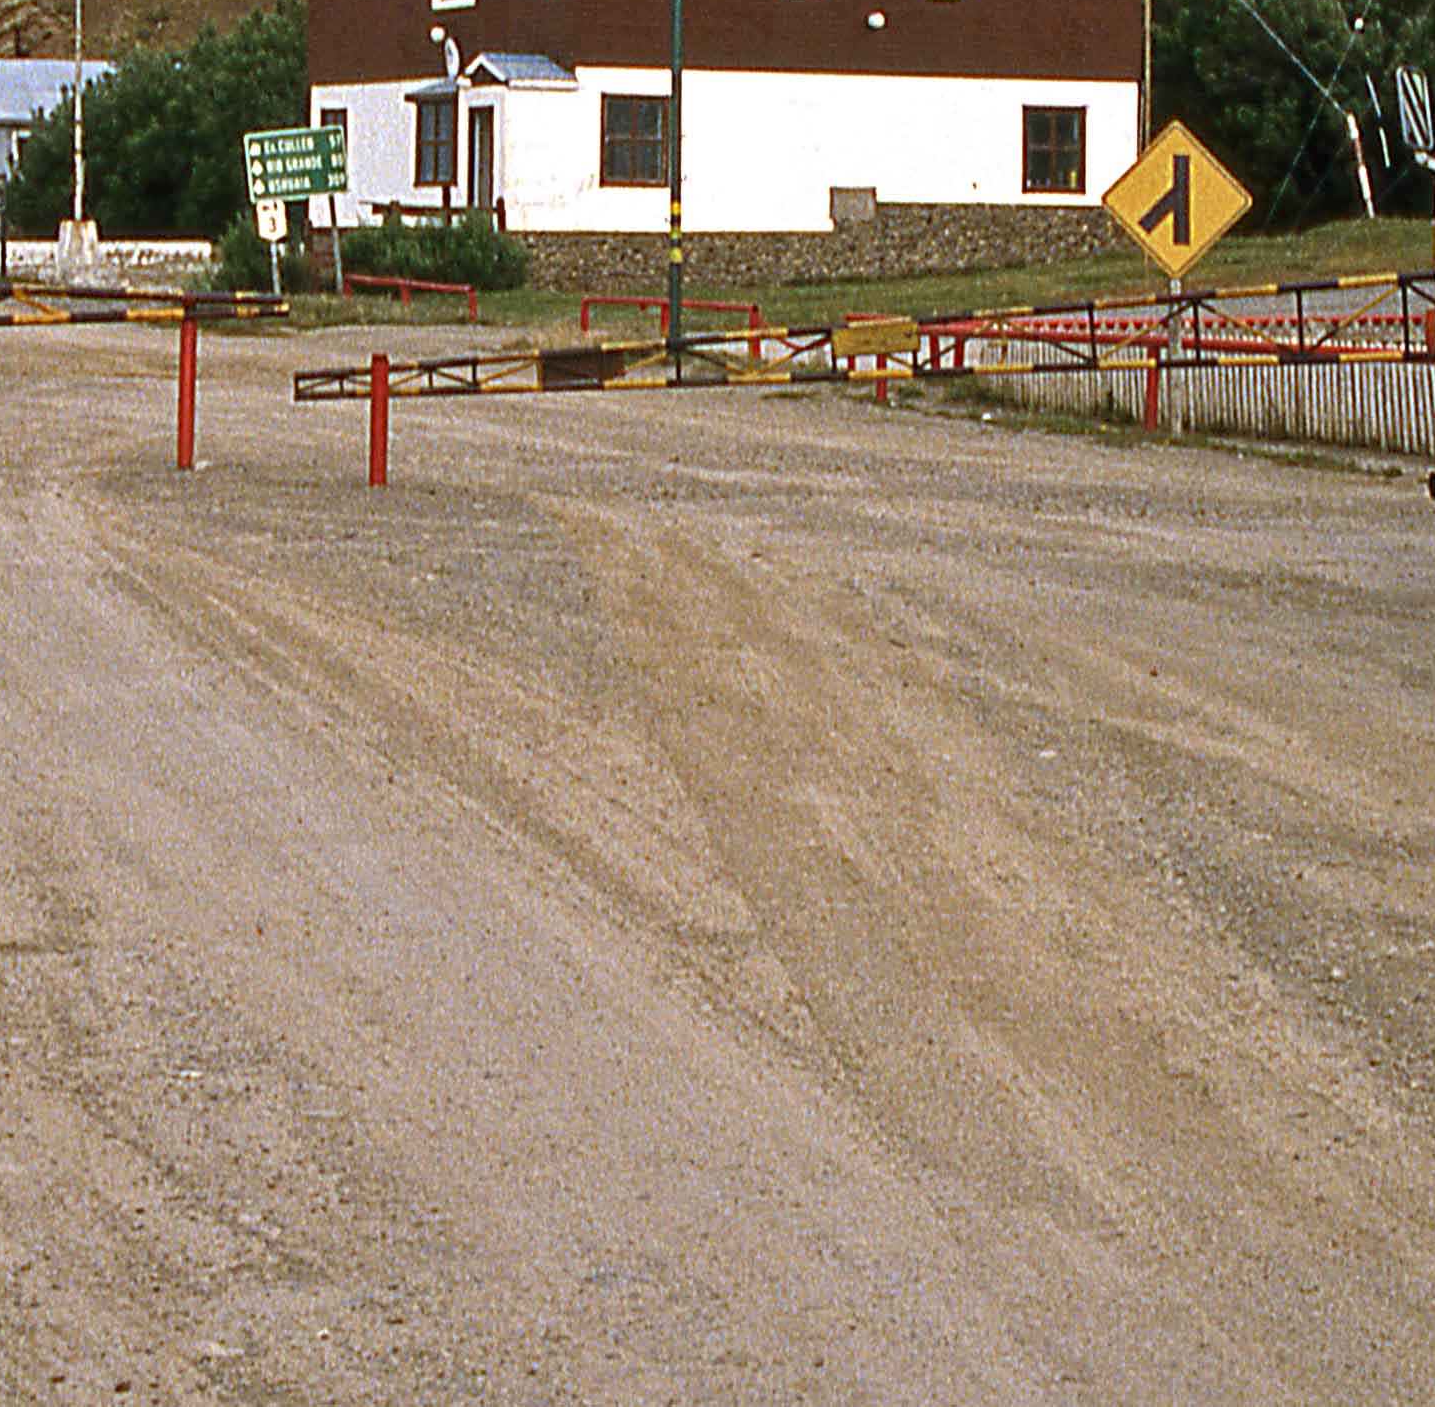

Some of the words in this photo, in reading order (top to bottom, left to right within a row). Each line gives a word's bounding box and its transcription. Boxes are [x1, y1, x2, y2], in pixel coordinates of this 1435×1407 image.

[286, 154, 322, 173] GRANDE
[268, 176, 311, 194] USHUAIA
[268, 216, 278, 233] 3
